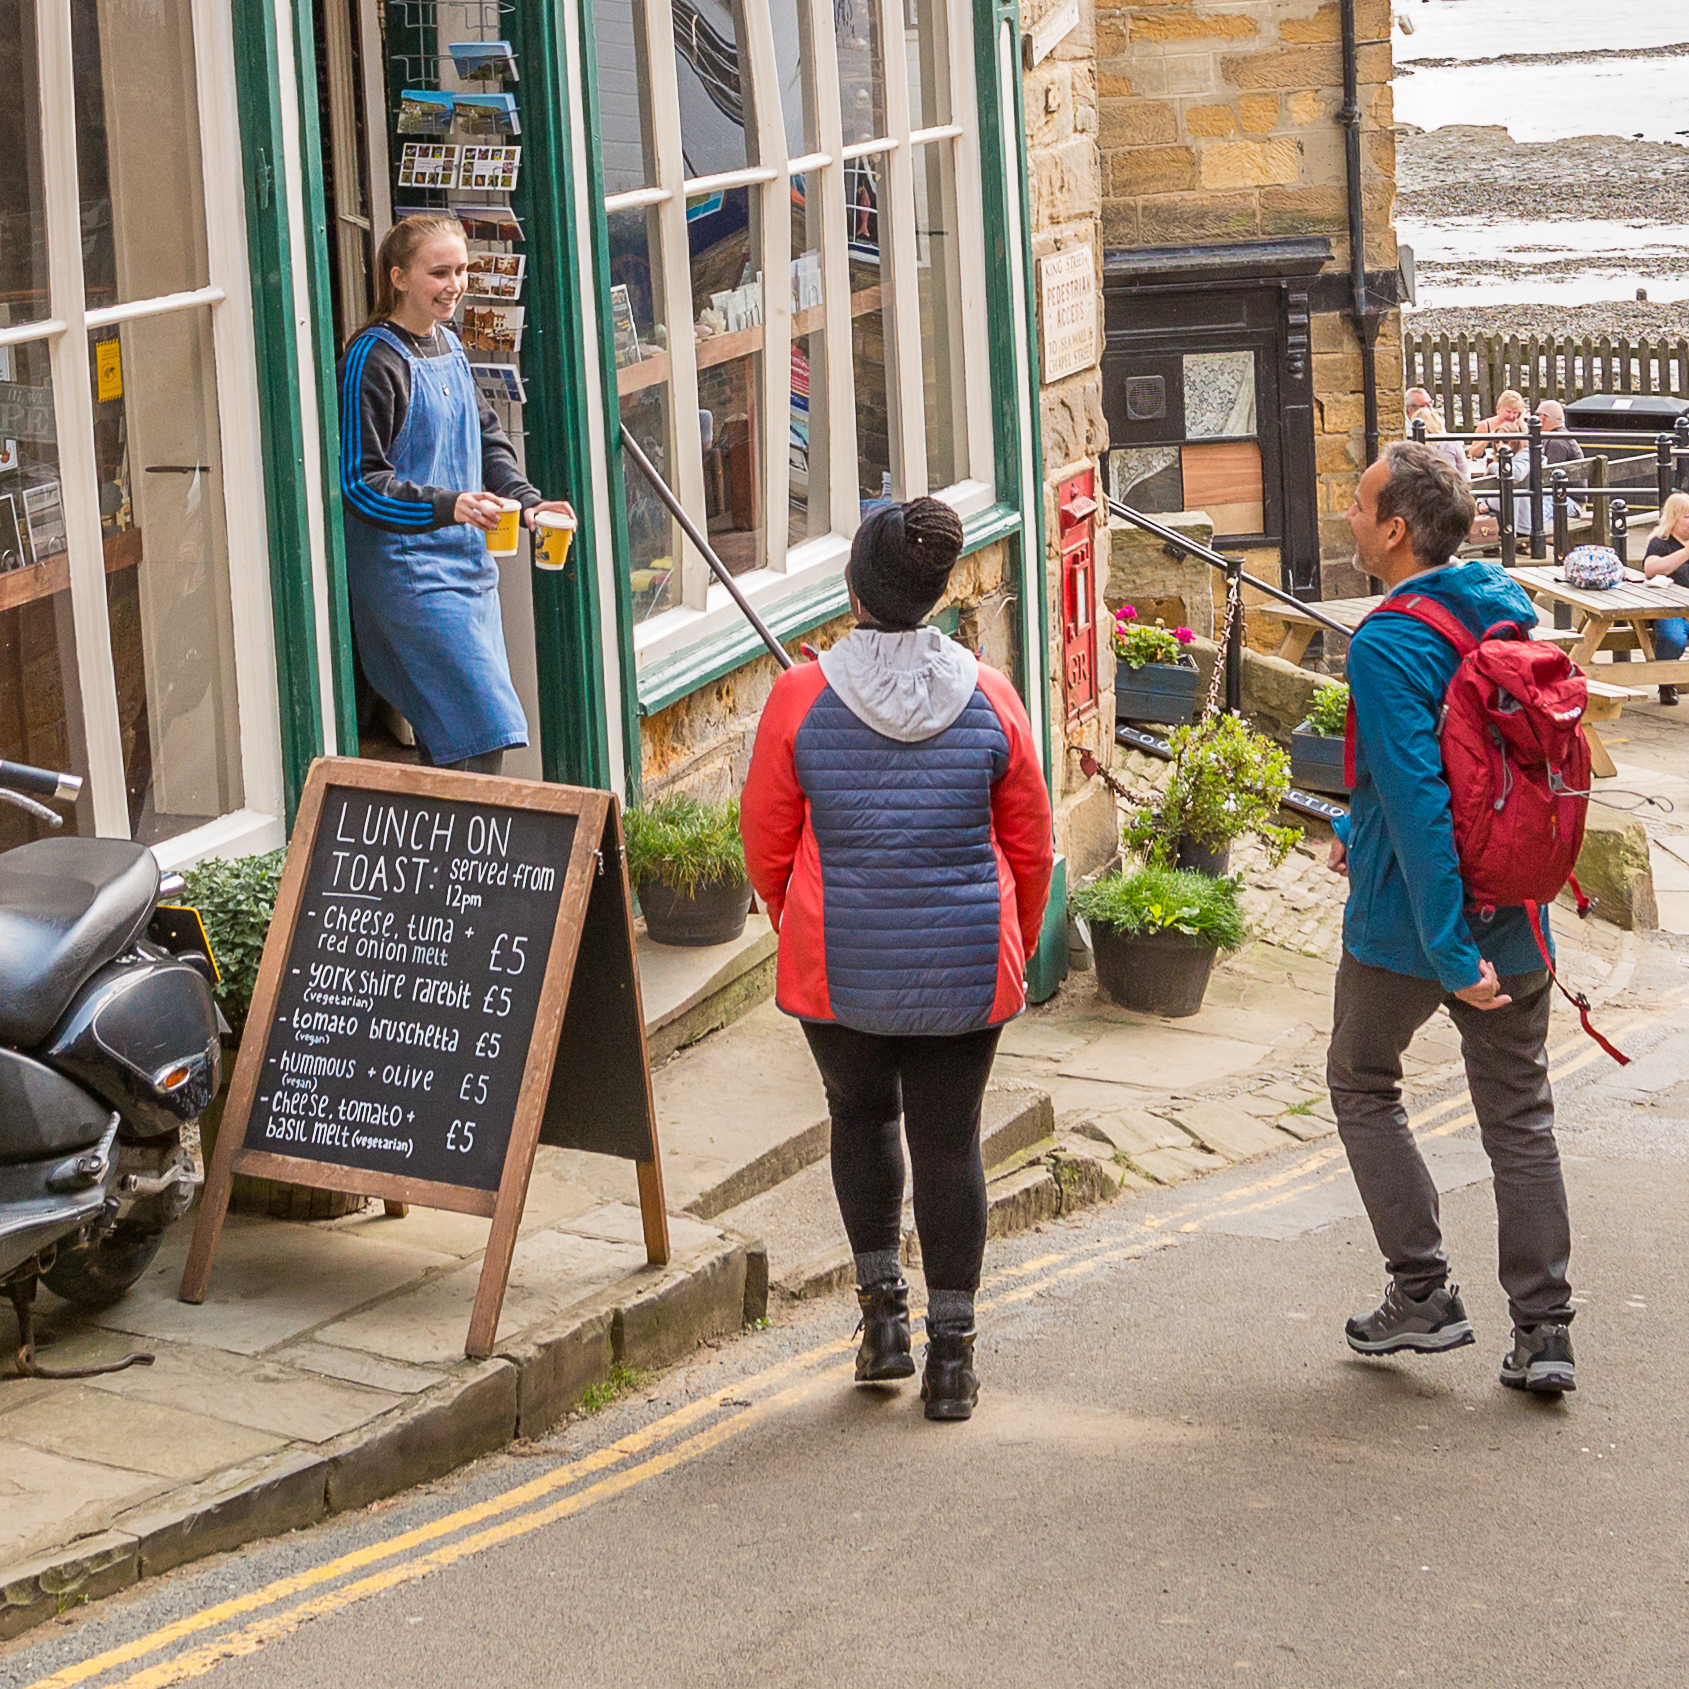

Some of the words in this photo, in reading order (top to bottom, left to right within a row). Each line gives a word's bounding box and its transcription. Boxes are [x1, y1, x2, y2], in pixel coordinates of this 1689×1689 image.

[1045, 259, 1063, 278] KING
[1066, 252, 1085, 272] STREET
[1047, 274, 1092, 308] PEDESTRIAN
[1057, 301, 1085, 330] ACCESS
[1048, 340, 1058, 356] TO
[1048, 353, 1072, 374] CHAPEL
[1074, 343, 1093, 364] STREET
[336, 801, 455, 853] LUNCH
[467, 815, 512, 858] ON
[332, 851, 439, 895] TOAST:
[449, 857, 509, 887] served
[512, 863, 556, 892] from
[445, 884, 483, 914] 12pm
[407, 913, 454, 944] tuna
[317, 932, 349, 954] red
[355, 936, 407, 963] onion
[411, 943, 449, 967] melt
[489, 933, 529, 976] £5
[303, 987, 374, 1012] (vegetarian)
[411, 976, 472, 1010] rarebit
[482, 984, 513, 1017] £5
[292, 1007, 359, 1036] tomato
[369, 1017, 460, 1052] bruschetta
[474, 1031, 502, 1059] £5
[294, 1029, 331, 1047] (vegan)
[279, 1049, 357, 1079] hummous
[382, 1064, 434, 1092] olive
[459, 1072, 490, 1105] £5
[281, 1072, 318, 1093] (vegan)
[337, 1098, 403, 1127] tomato
[265, 1115, 308, 1143] basil
[311, 1120, 349, 1148] melt
[351, 1129, 414, 1159] (vegetarian)
[446, 1119, 477, 1153] £5
